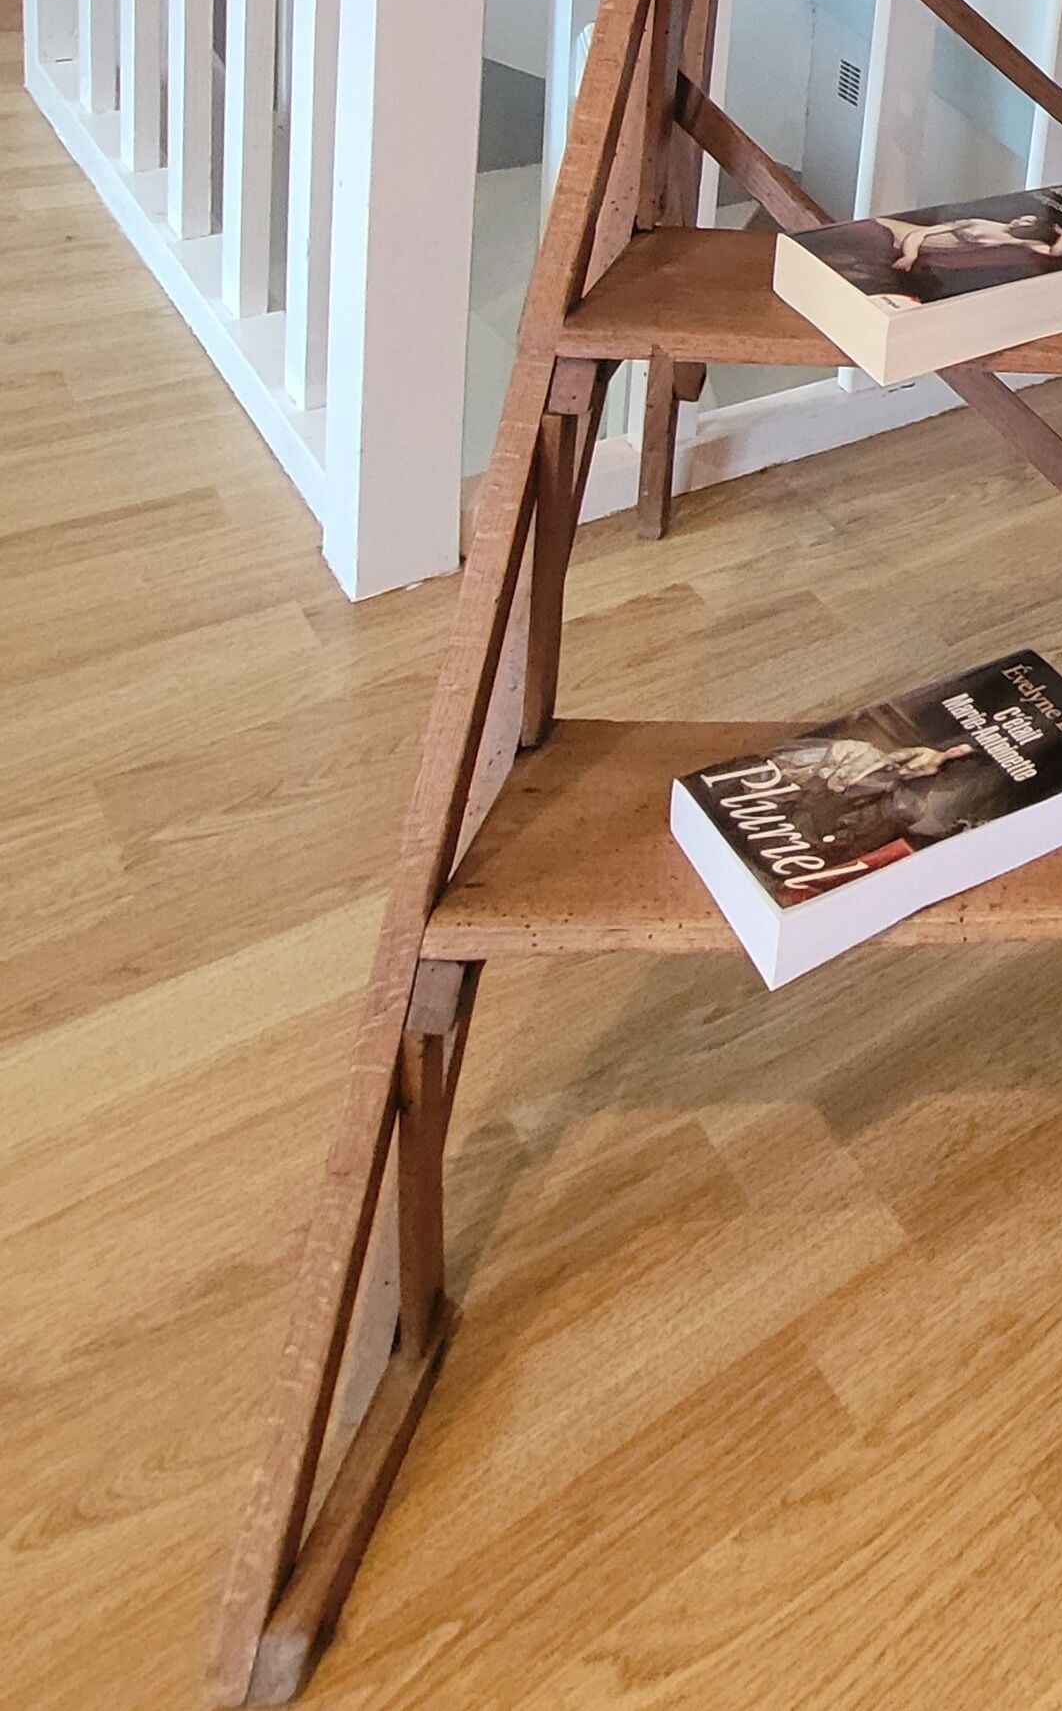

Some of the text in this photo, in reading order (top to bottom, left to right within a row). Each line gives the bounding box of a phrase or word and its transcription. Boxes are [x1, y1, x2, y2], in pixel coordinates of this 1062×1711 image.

[993, 706, 1044, 746] C'était
[1001, 663, 1062, 720] Évelyne
[941, 692, 1038, 782] Marie-Antoinette
[700, 759, 869, 889] Pluriel
